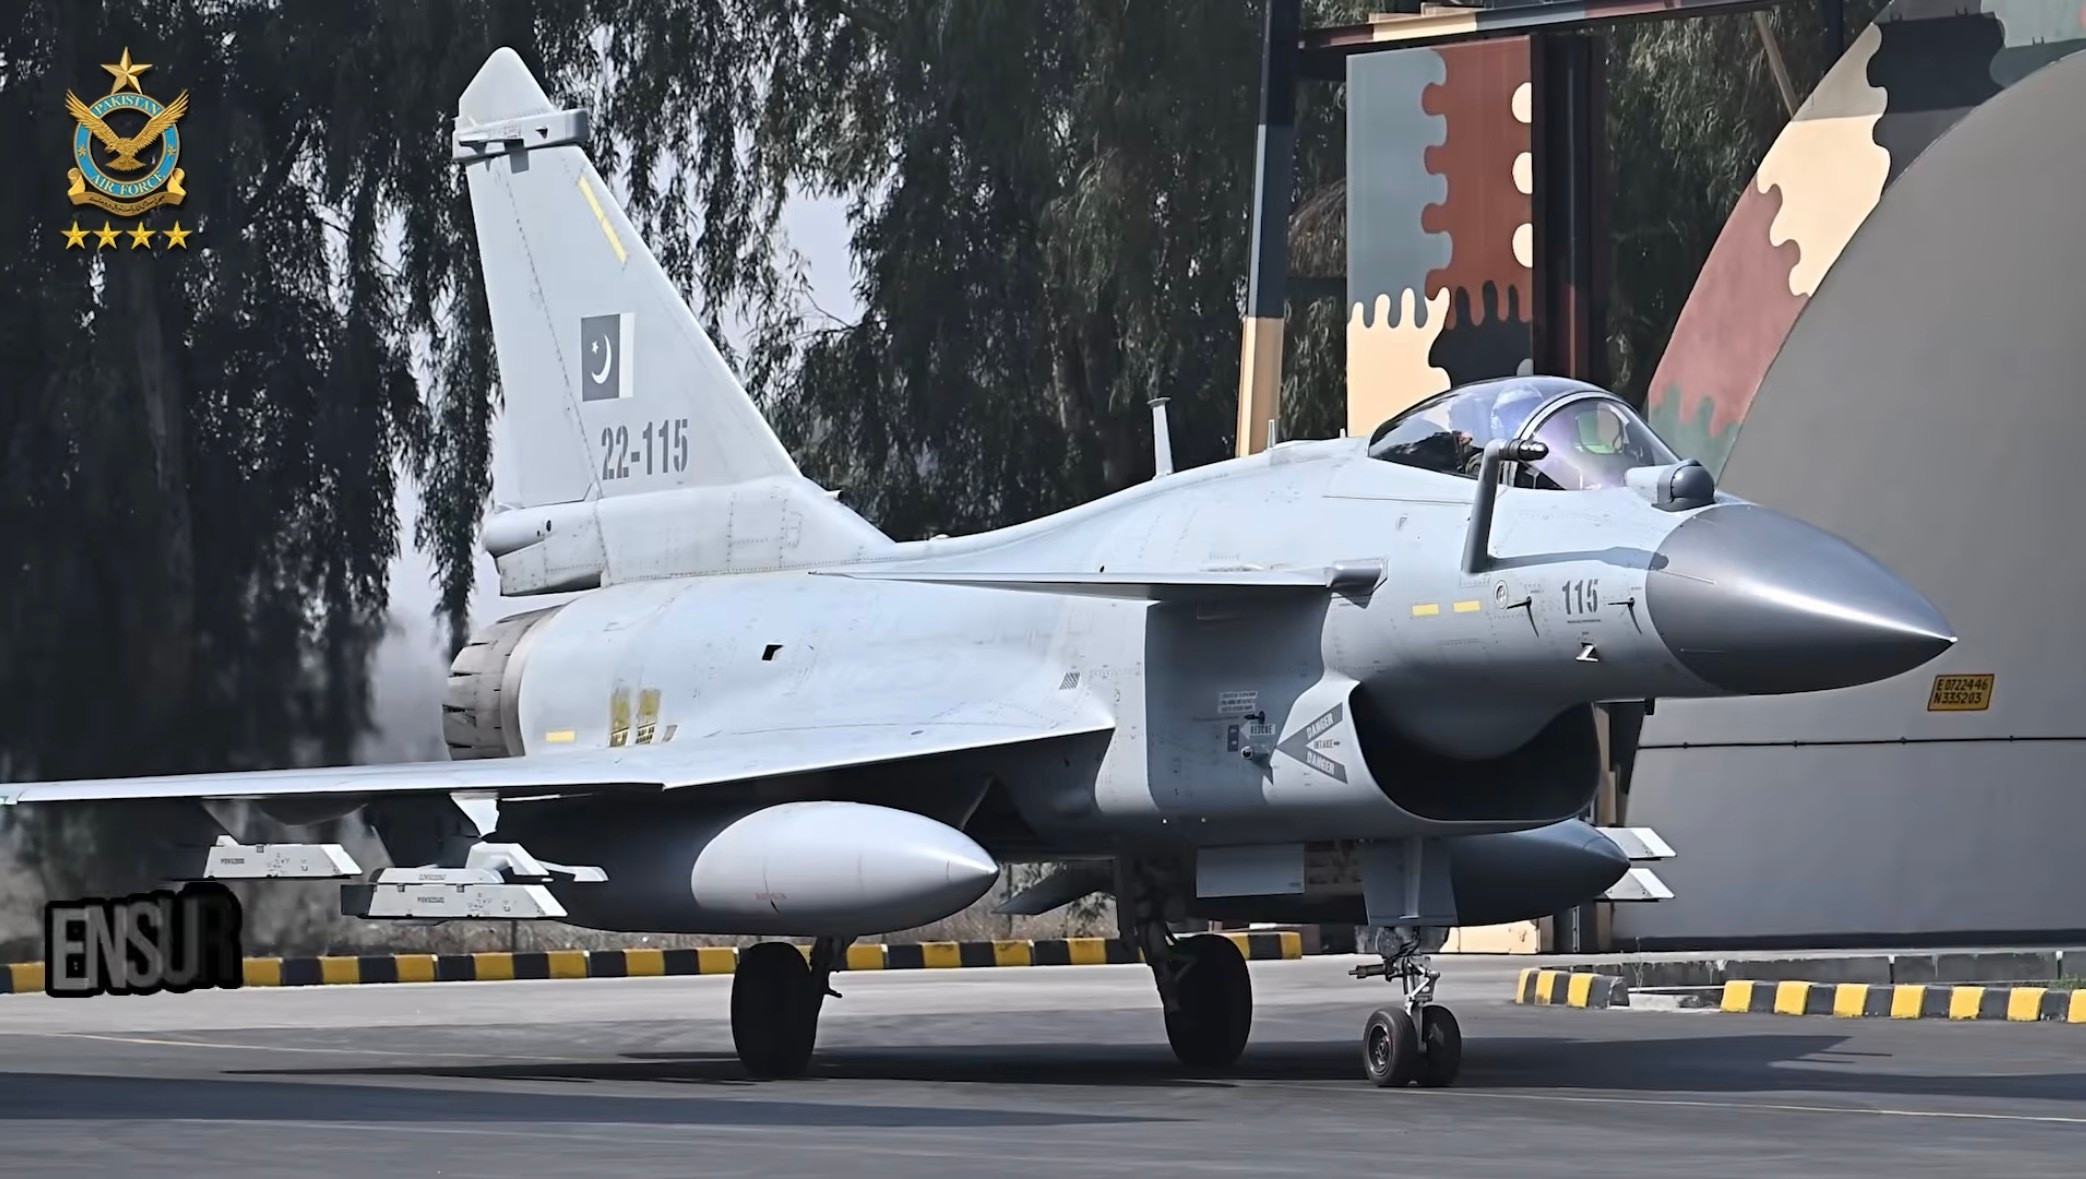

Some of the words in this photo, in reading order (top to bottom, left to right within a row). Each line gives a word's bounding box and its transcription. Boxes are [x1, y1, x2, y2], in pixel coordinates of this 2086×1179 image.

[601, 418, 688, 480] 22-115
[1562, 579, 1599, 615] 115
[1251, 725, 1273, 735] RESCUE
[1306, 713, 1334, 739] DANGER
[1313, 739, 1333, 749] INTAKE
[1306, 751, 1335, 775] DANGER
